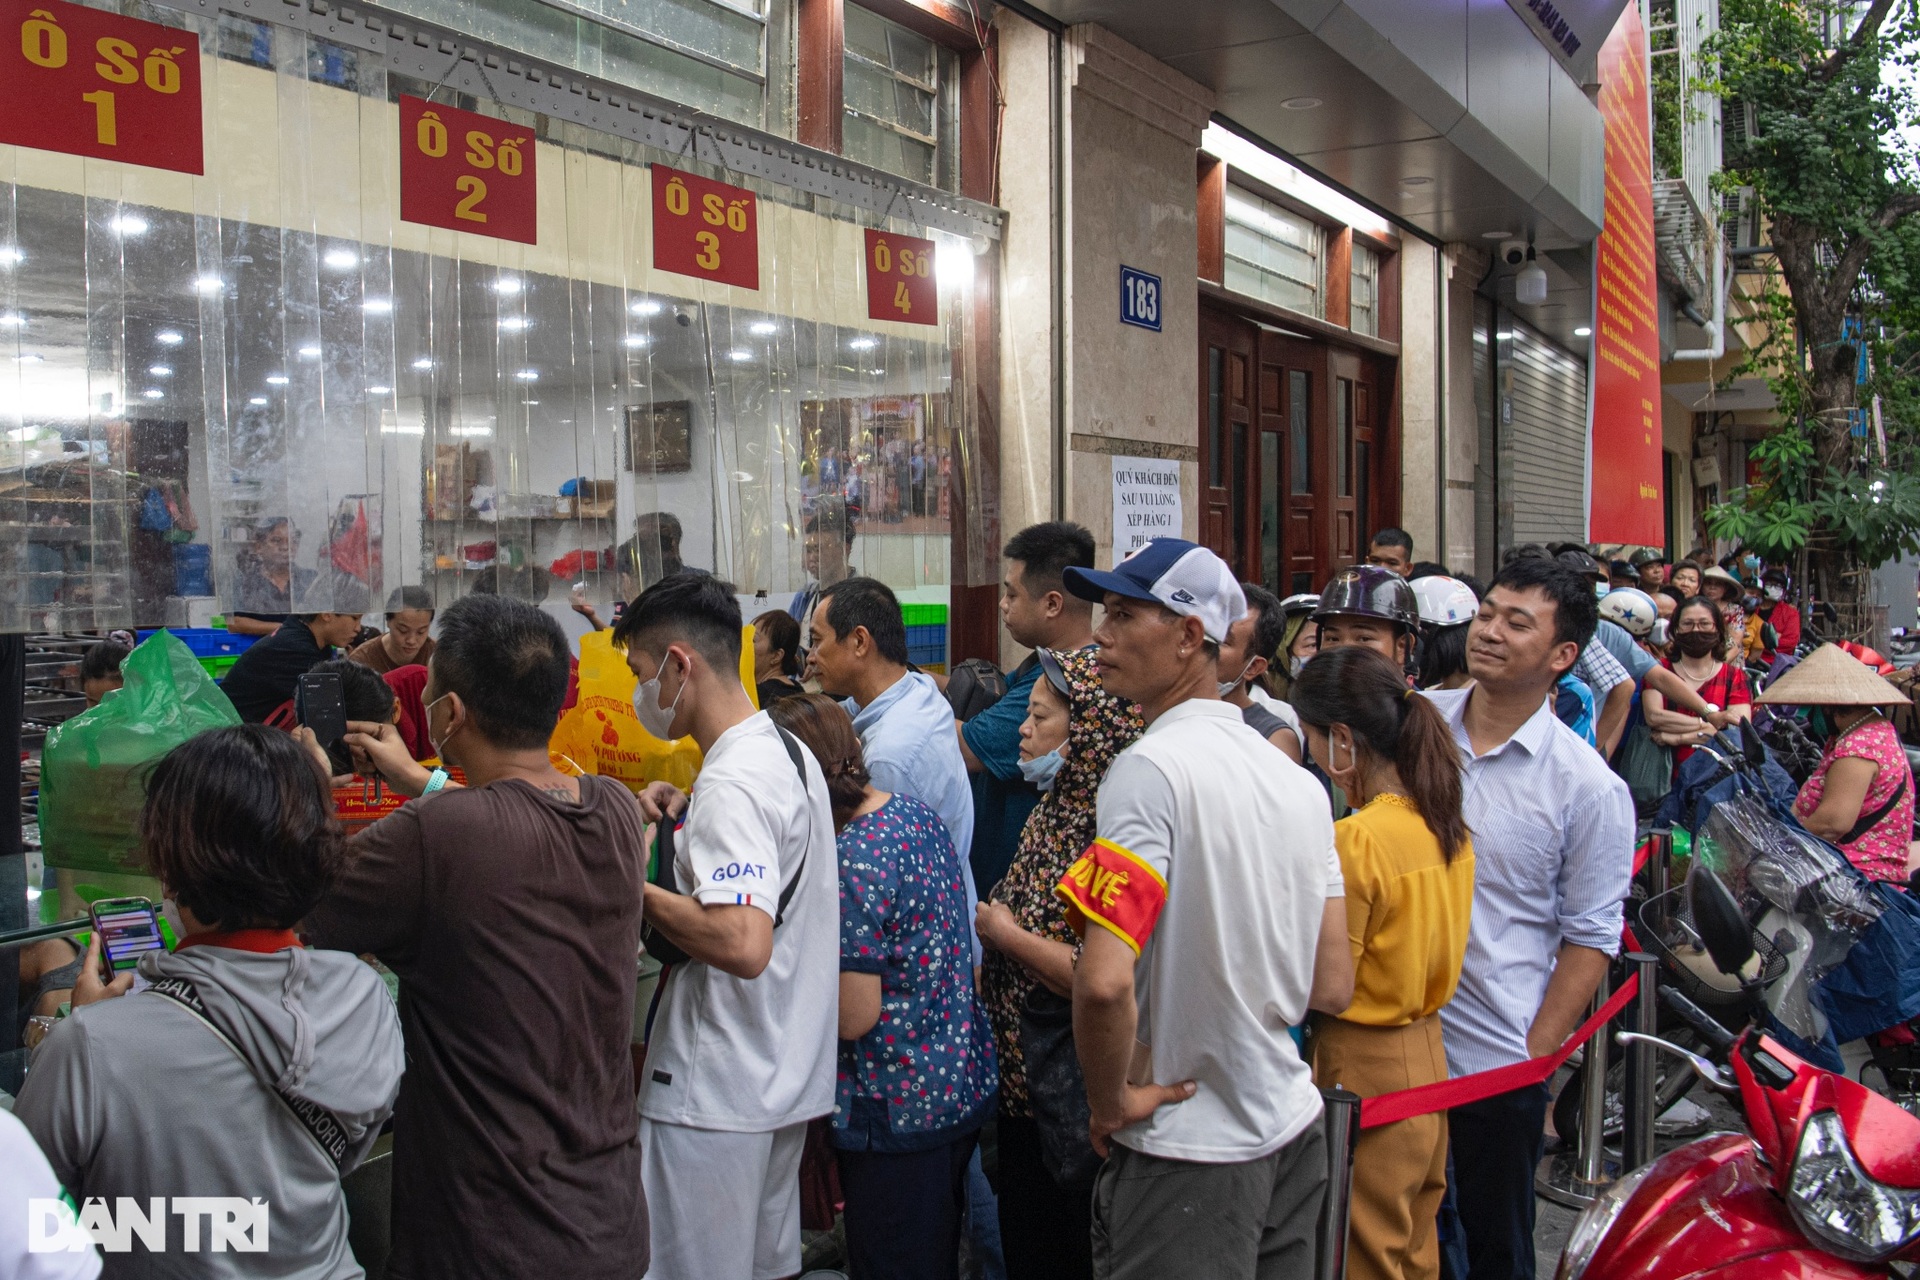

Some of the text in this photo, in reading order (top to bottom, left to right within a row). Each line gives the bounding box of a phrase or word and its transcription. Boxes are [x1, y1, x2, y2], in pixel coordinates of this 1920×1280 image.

[21, 9, 68, 69] Ô
[83, 90, 118, 147] 1
[416, 111, 448, 158] Ô
[455, 175, 488, 223] 2
[665, 176, 690, 217] Ô
[695, 231, 721, 271] 3
[874, 238, 892, 273] Ô
[893, 281, 912, 315] 4
[1126, 276, 1157, 322] 183
[1115, 468, 1133, 486] QUÝ
[1134, 469, 1162, 485] KHÁCH
[1121, 490, 1175, 506] SAU VUI LÒNG
[1143, 510, 1167, 527] HÀNG
[711, 862, 767, 882] GOAT
[1090, 865, 1129, 908] VỆ
